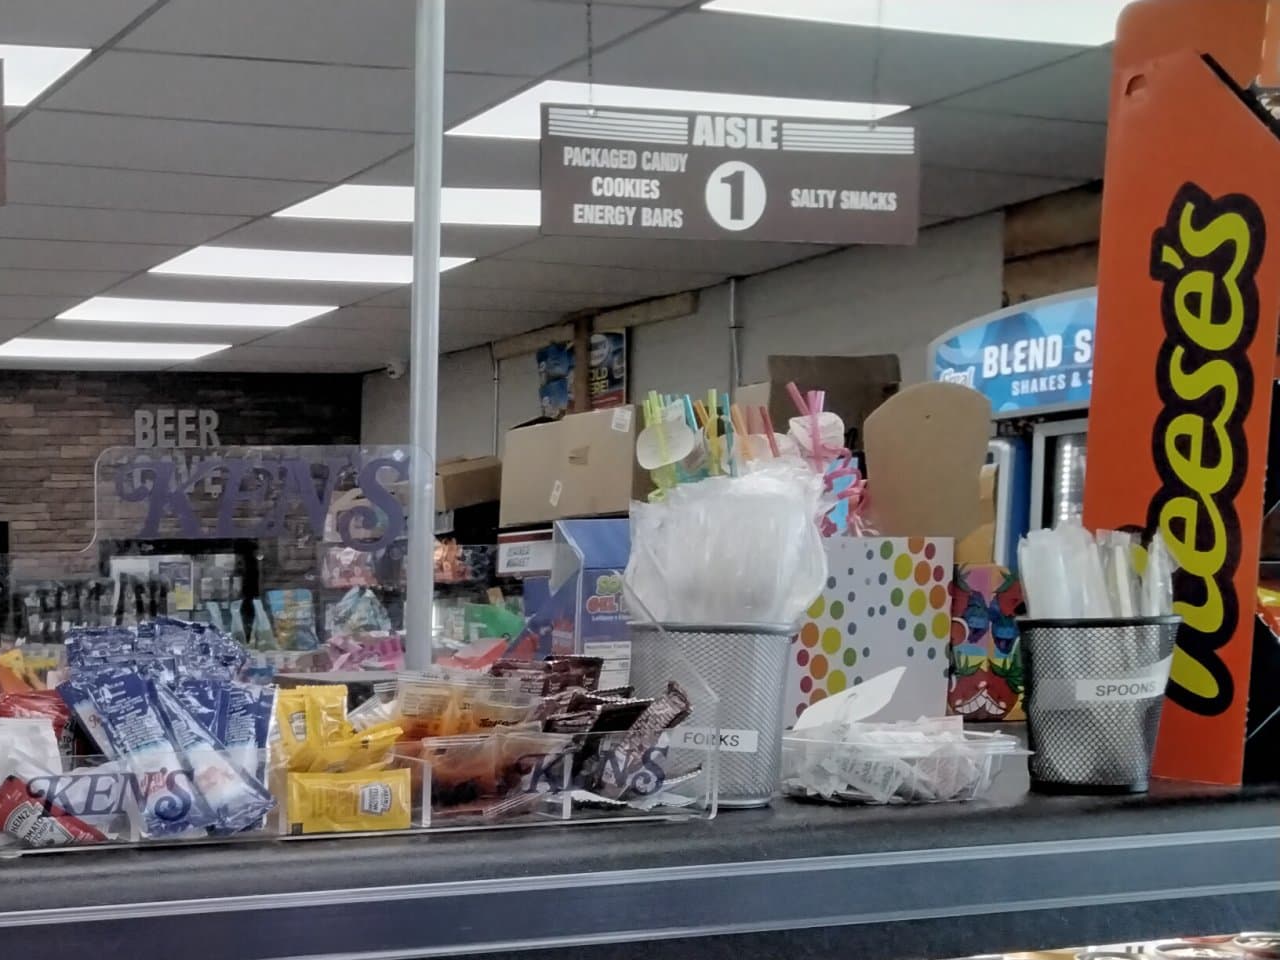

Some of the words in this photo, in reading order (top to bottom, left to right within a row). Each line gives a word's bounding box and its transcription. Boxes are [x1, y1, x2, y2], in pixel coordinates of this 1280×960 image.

[692, 115, 778, 149] AISLE
[563, 146, 637, 170] PACKAGED
[641, 151, 688, 173] CANDY
[591, 176, 660, 199] COOKIES
[720, 171, 745, 220] 1
[791, 188, 836, 209] SALTY
[840, 190, 897, 211] SNACKS
[573, 204, 635, 226] ENERGY
[641, 208, 683, 228] BARS
[982, 334, 1062, 379] BLEND
[1012, 373, 1066, 396] SHAKES
[1071, 373, 1082, 387] &
[134, 408, 220, 449] BEER
[1096, 681, 1156, 697] SPOONS
[683, 731, 739, 748] FORKS
[26, 766, 195, 820] KEN'S
[9, 809, 31, 833] HEINZ
